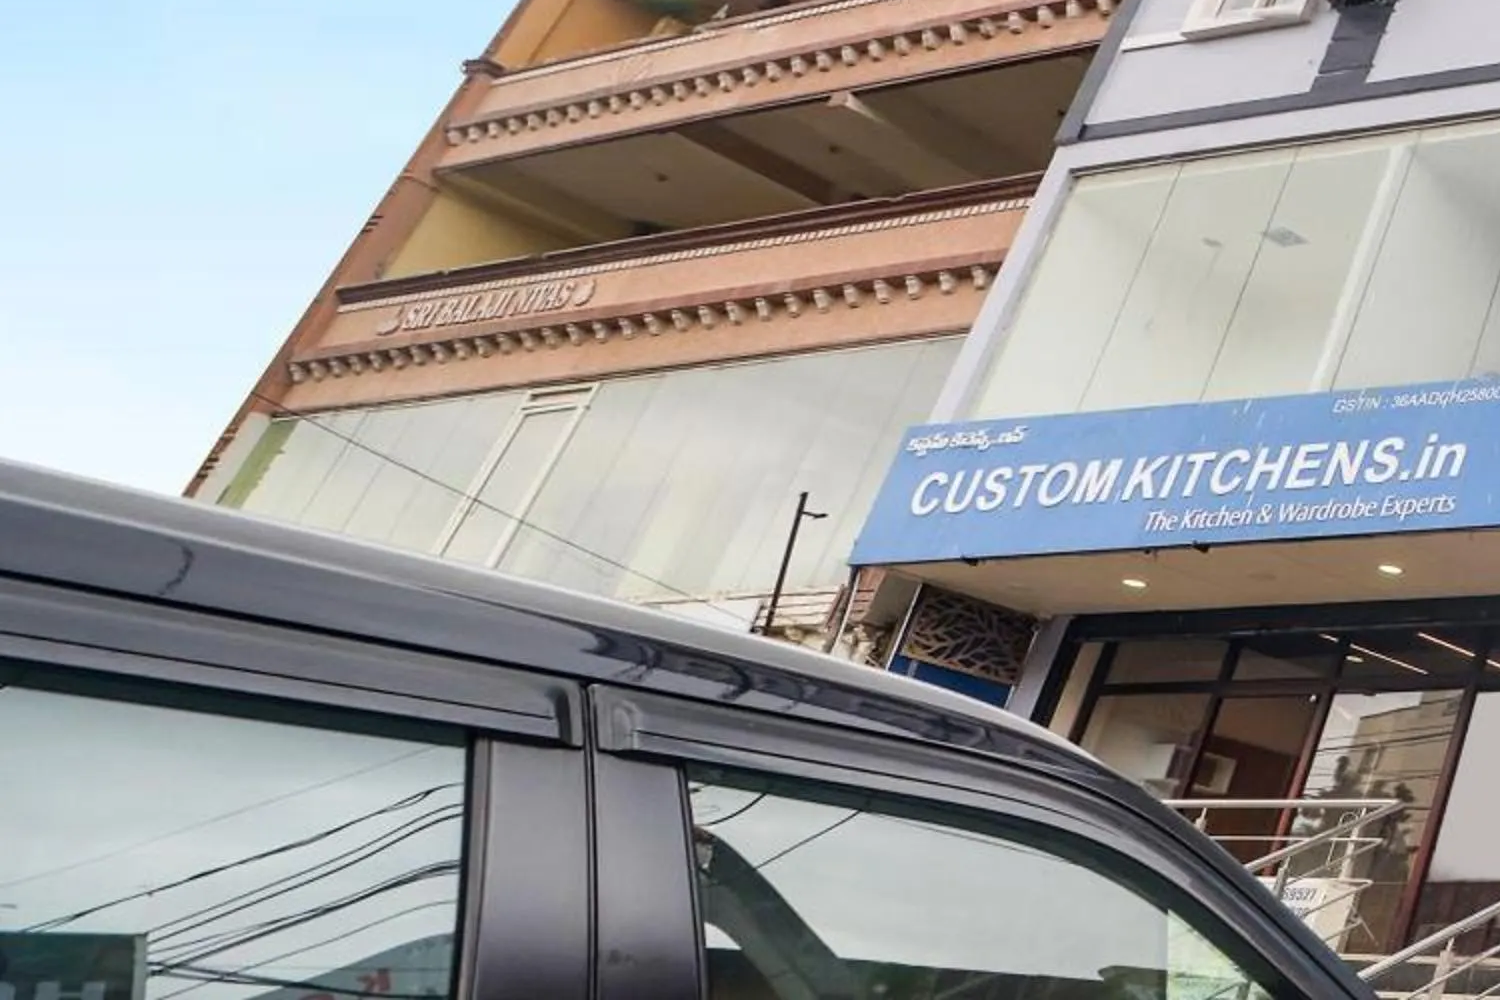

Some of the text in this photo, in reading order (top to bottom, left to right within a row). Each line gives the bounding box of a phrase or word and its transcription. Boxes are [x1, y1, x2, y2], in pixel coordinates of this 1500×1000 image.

[1145, 494, 1456, 532] The Kitchen & Wardrobe Experts
